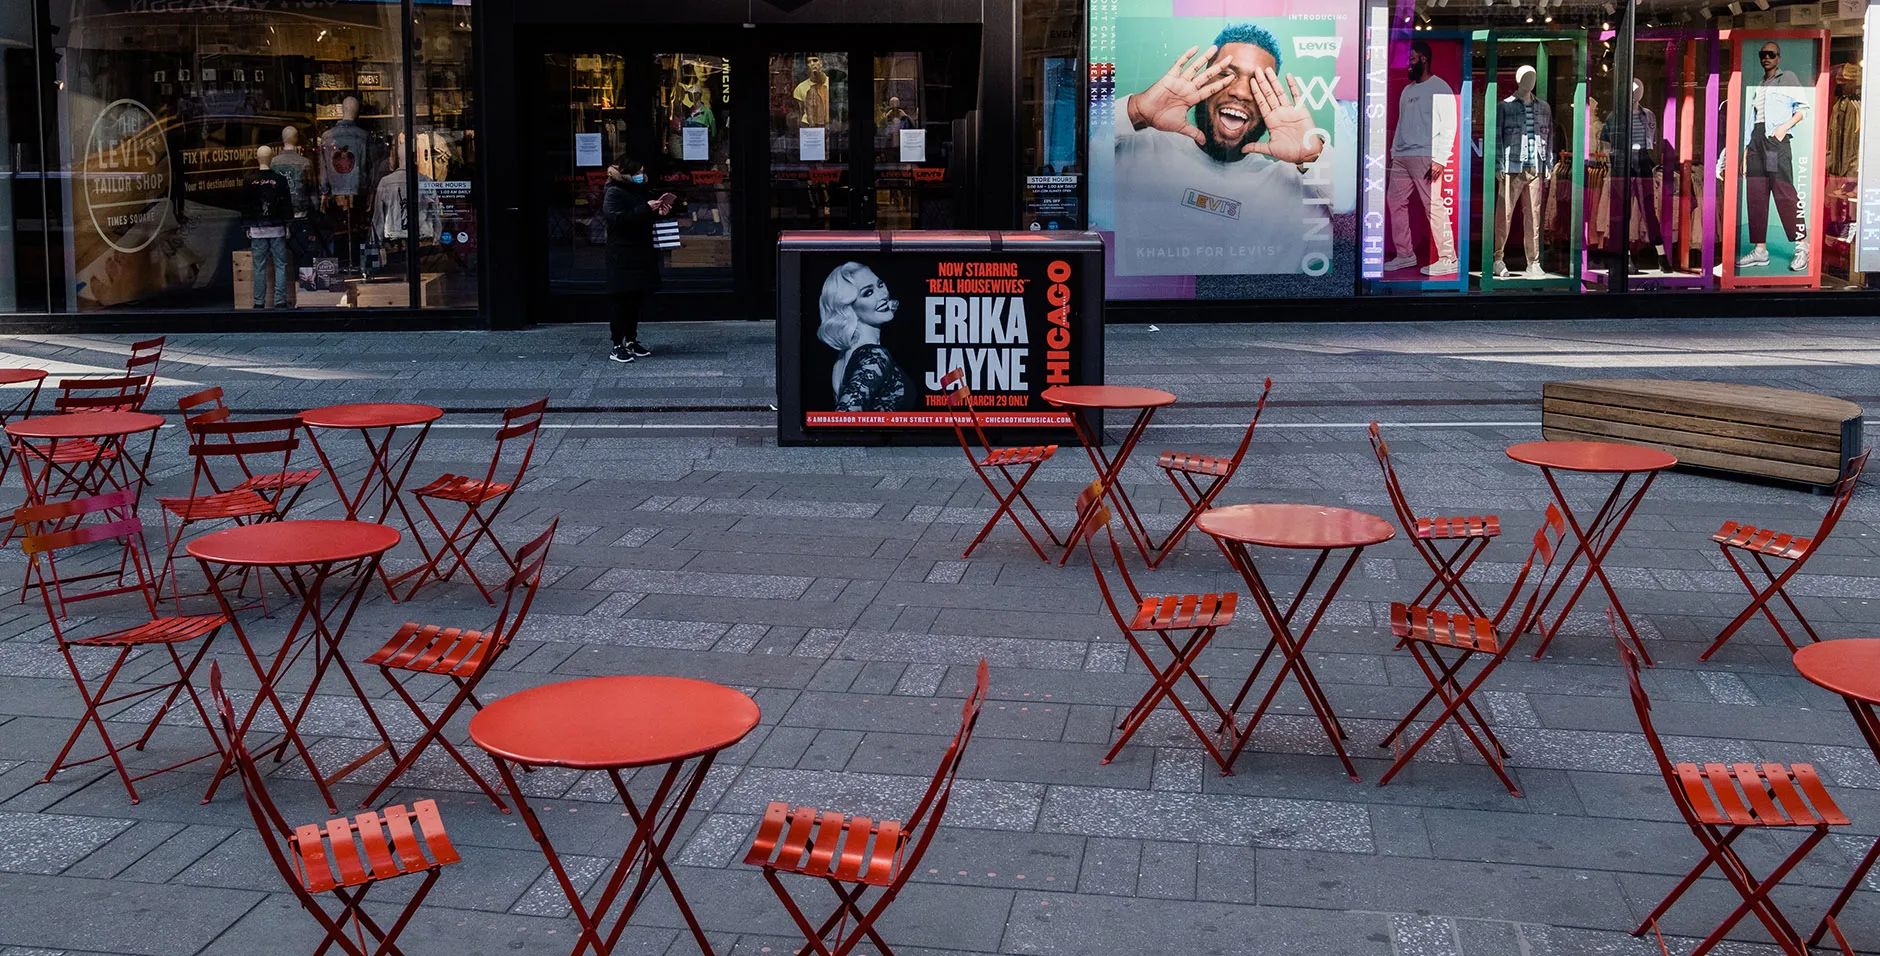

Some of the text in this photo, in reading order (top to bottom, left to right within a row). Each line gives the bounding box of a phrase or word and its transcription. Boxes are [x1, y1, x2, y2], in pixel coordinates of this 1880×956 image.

[360, 75, 379, 85] OMEN'S
[721, 57, 730, 103] MENS
[98, 139, 157, 169] LEVI'S
[183, 151, 198, 164] FIX
[94, 174, 164, 195] TAILOR SHOP
[183, 180, 197, 193] Your
[1796, 156, 1808, 219] BALLOON
[1187, 191, 1238, 217] LEVI'S
[1302, 128, 1331, 277] CHINO
[1443, 188, 1455, 216] FOR
[107, 212, 155, 227] TIMES SQUARE
[1136, 246, 1276, 257] KHALID FOR LEVI'S
[938, 262, 1018, 277] NOW STARRING
[925, 296, 1029, 344] ERIKA
[925, 348, 1029, 391] JAYNE
[996, 394, 1007, 407] 29
[1008, 394, 1029, 407] ONLY
[945, 416, 980, 424] BROADWY
[985, 416, 1071, 424] CHICAGOTHEMUSICAL.COM
